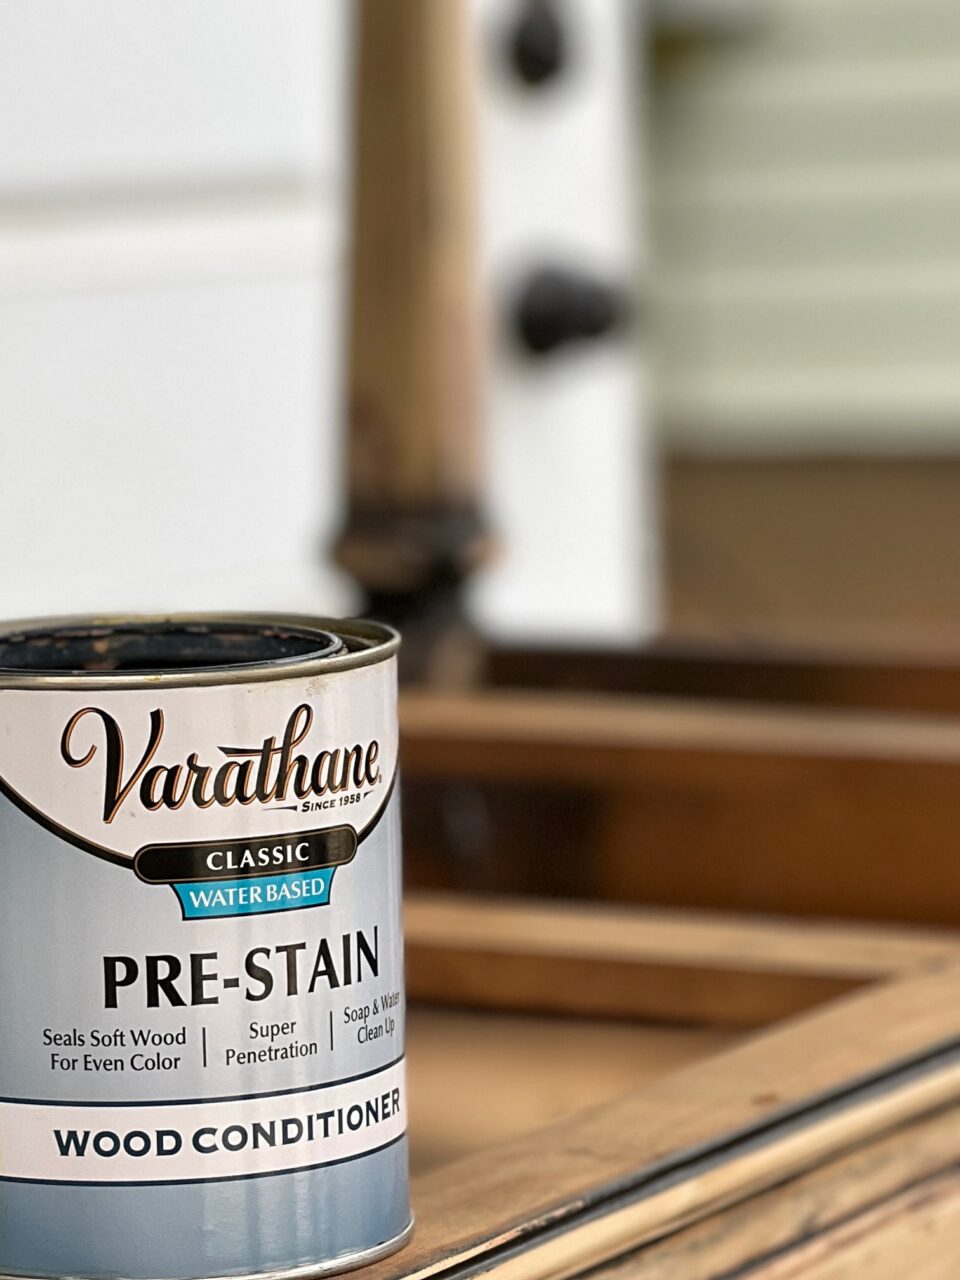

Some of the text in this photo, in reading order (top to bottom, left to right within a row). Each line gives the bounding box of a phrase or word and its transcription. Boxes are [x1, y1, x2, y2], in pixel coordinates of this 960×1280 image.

[61, 703, 380, 824] Varathane
[339, 792, 362, 807] 1958
[206, 842, 310, 871] CLASSIC
[189, 877, 325, 909] WATER BASED
[102, 925, 379, 1009] PRE-STAIN
[343, 991, 400, 1024] Soap & Water
[42, 1026, 187, 1047] Seals Soft Wood
[249, 1020, 297, 1043] Super
[357, 1015, 395, 1044] Clean Up
[50, 1052, 181, 1071] For Even Color
[225, 1039, 318, 1066] Penetration
[53, 1087, 401, 1158] WOOD CONDITIONER
